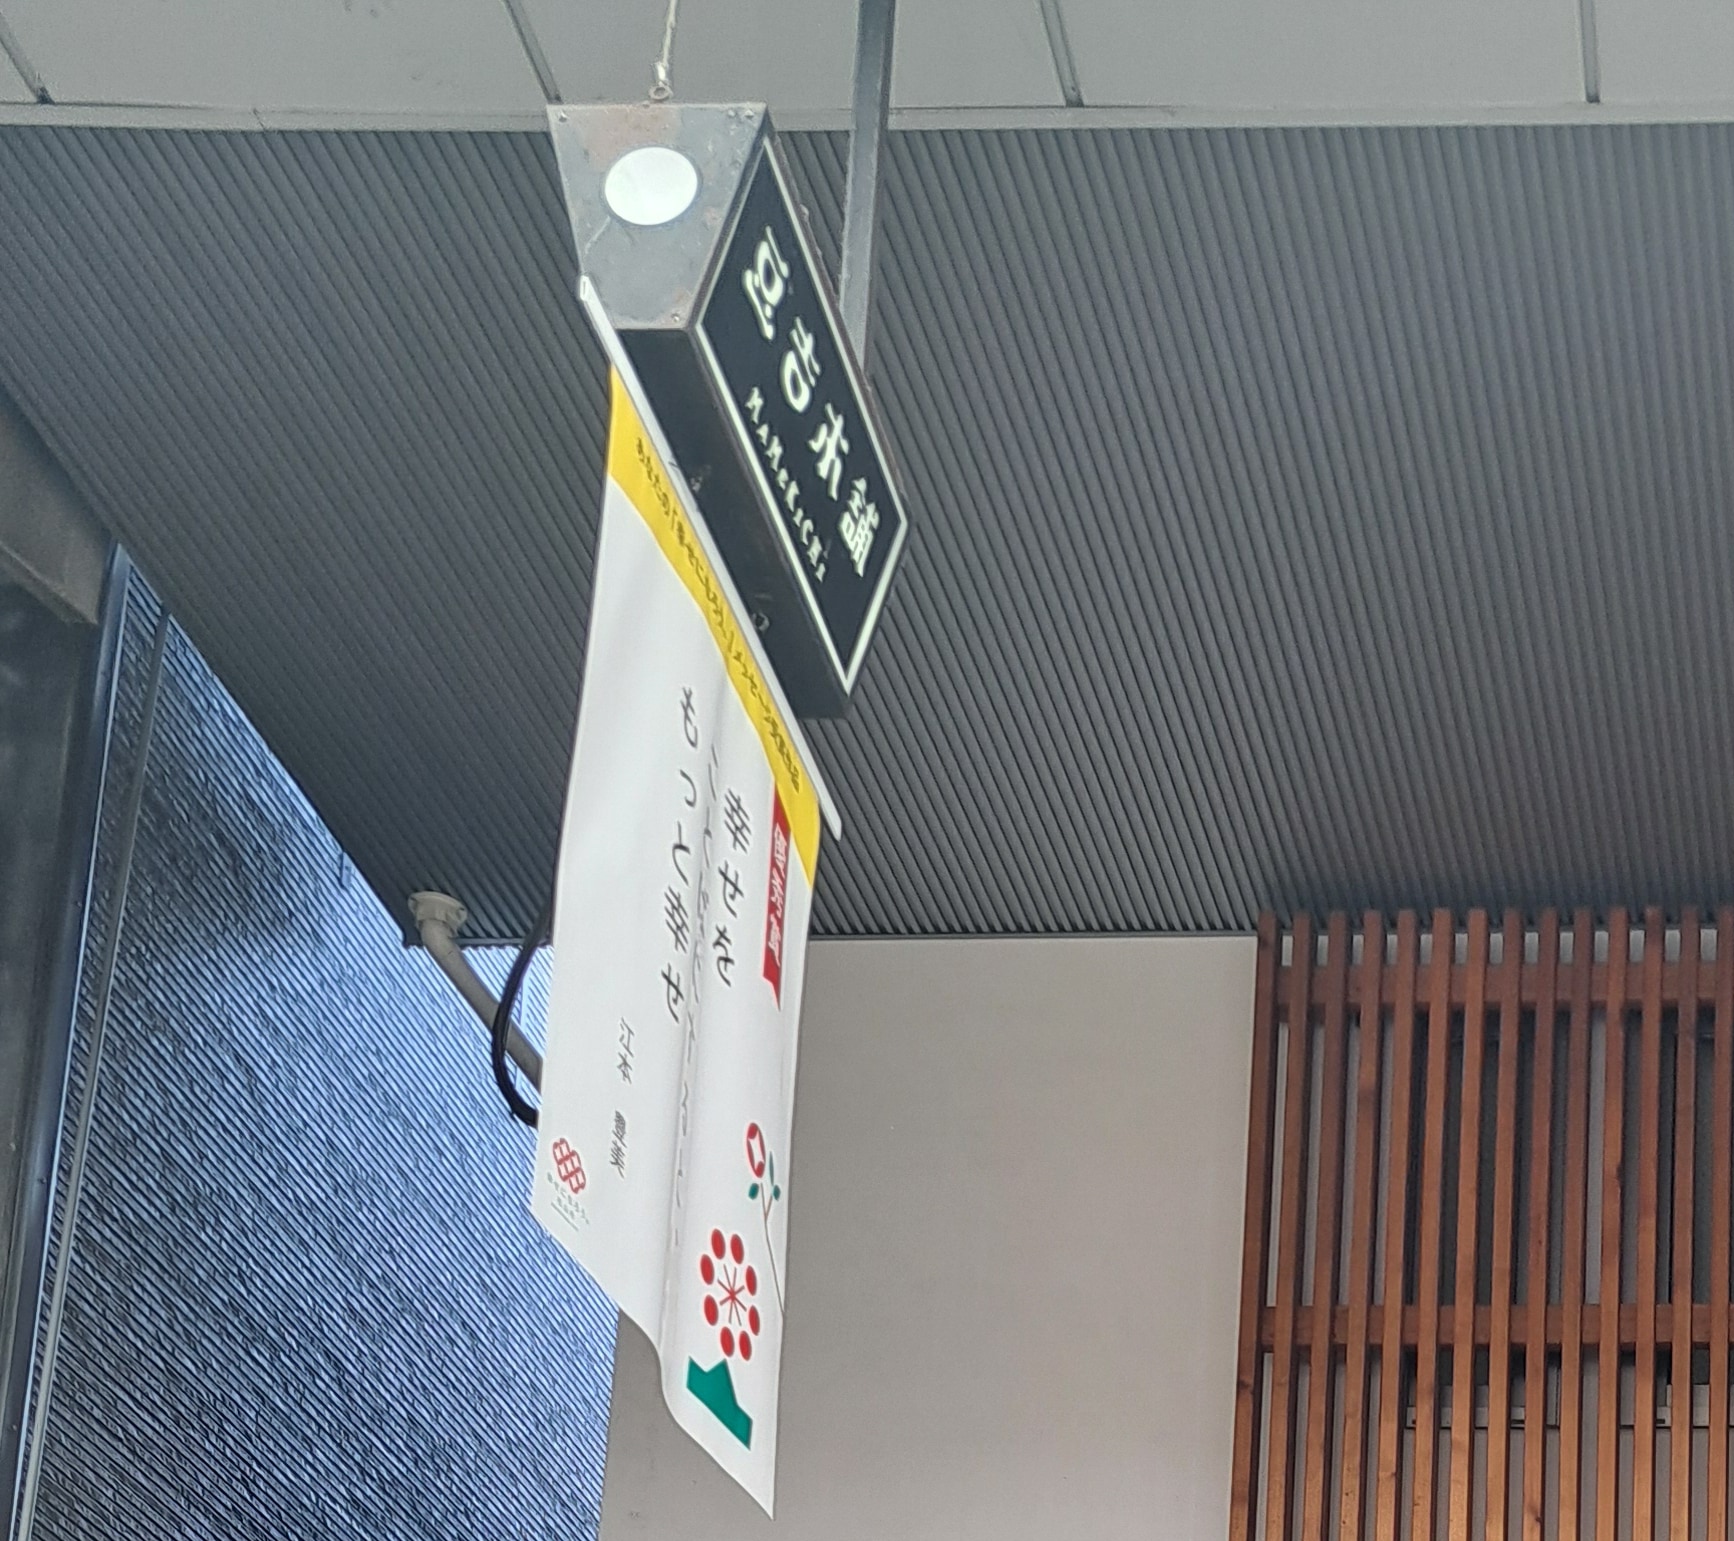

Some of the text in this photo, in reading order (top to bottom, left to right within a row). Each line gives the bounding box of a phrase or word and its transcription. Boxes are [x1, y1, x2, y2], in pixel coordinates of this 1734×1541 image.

[744, 226, 880, 577] 豆吉本舗
[661, 687, 697, 1023] もっと幸せ
[713, 787, 751, 987] 幸せを
